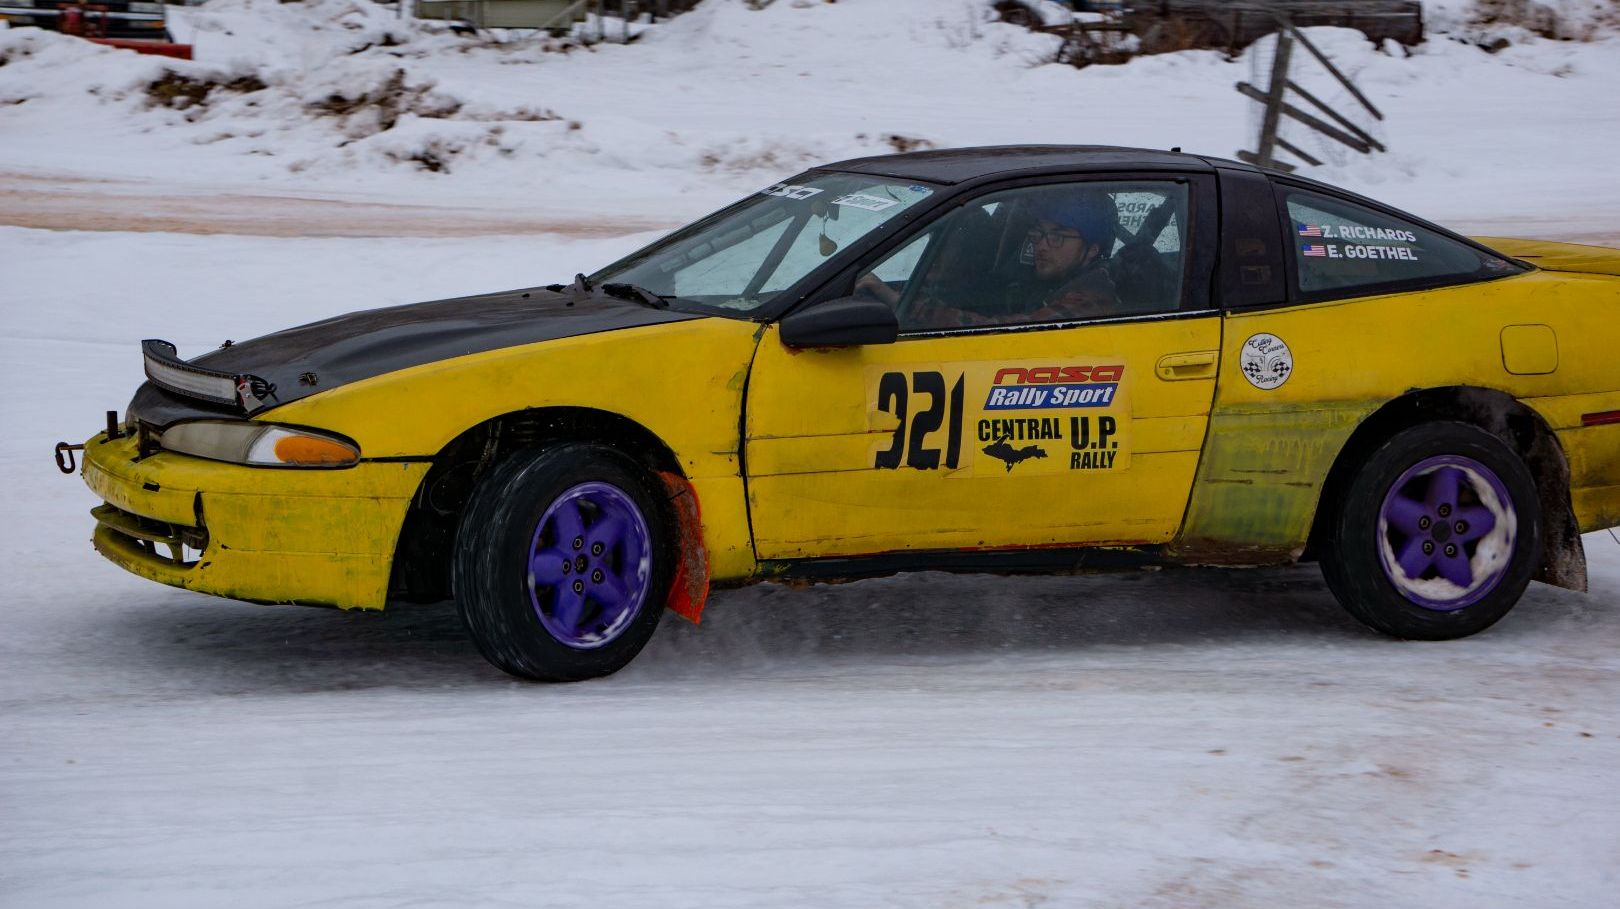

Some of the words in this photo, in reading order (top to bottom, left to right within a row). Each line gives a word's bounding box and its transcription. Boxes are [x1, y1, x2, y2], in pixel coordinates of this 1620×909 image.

[1321, 225, 1338, 239] Z.
[1339, 225, 1417, 243] RICHARDS
[1327, 244, 1343, 258] E.
[1345, 244, 1418, 261] GOETHEL
[988, 388, 1048, 407] Rally
[1050, 386, 1114, 406] Sport
[874, 371, 965, 471] 921
[978, 417, 1063, 441] CENTRAL
[1070, 416, 1119, 450] U.P.
[1070, 451, 1117, 470] RALLY
